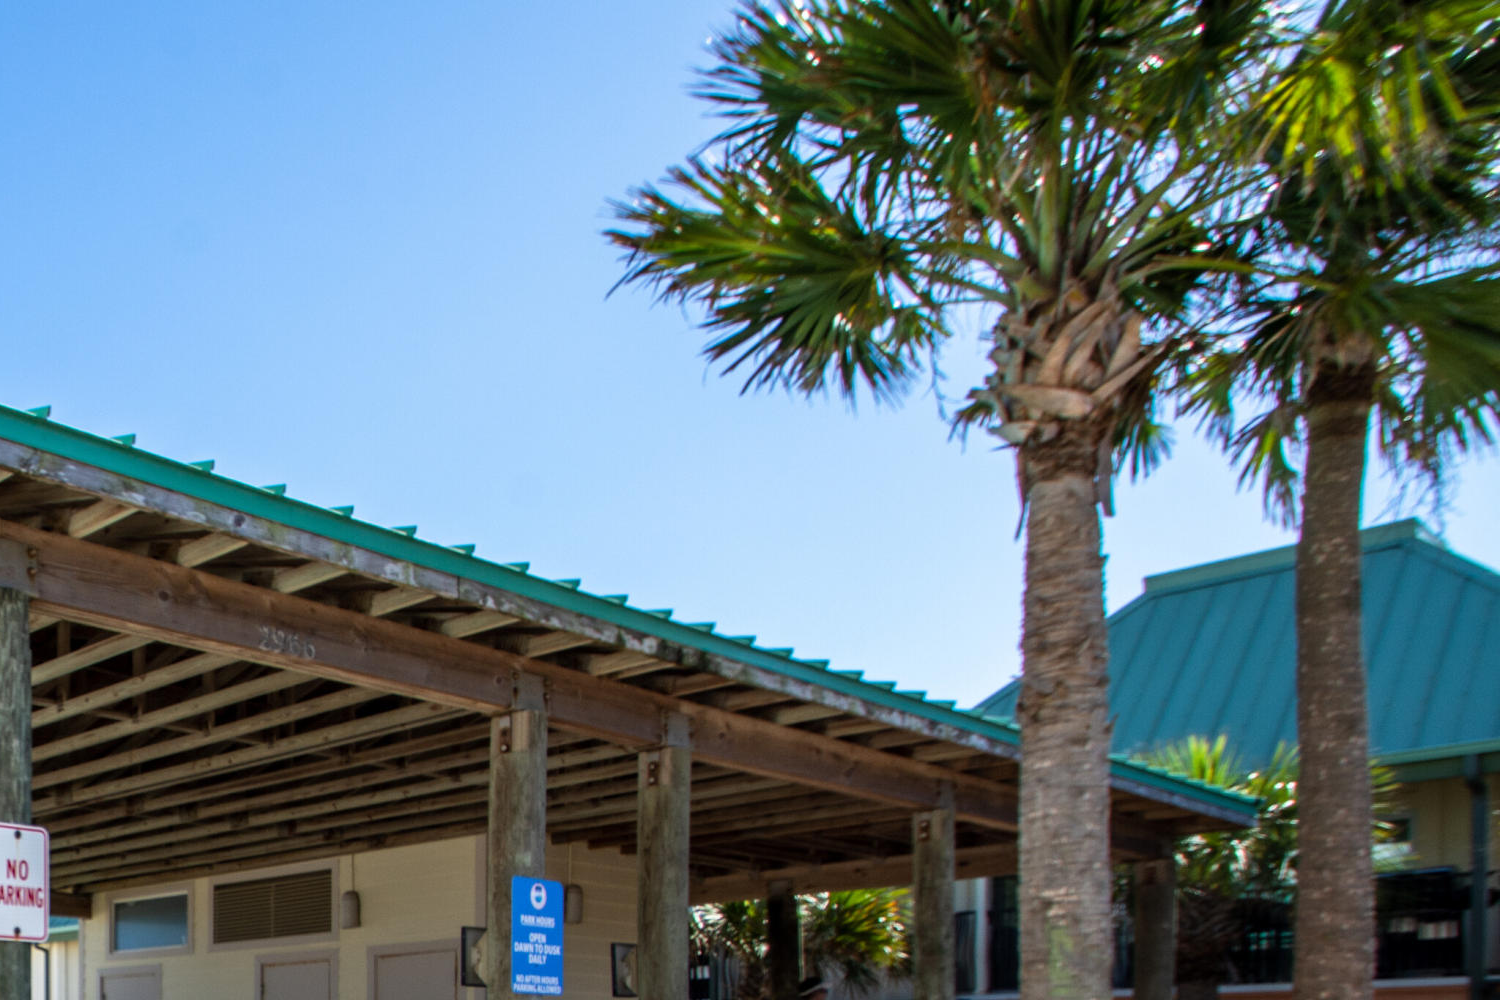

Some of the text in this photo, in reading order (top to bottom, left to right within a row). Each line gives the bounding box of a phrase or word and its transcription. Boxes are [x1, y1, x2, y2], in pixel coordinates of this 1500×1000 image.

[6, 858, 29, 881] NO
[520, 914, 555, 928] PARK HOURS
[529, 932, 547, 944] OPEN
[514, 942, 561, 956] DAWN TO DUSK
[528, 953, 547, 965] DAILY
[541, 976, 559, 985] HOURS
[513, 983, 537, 993] PARKING
